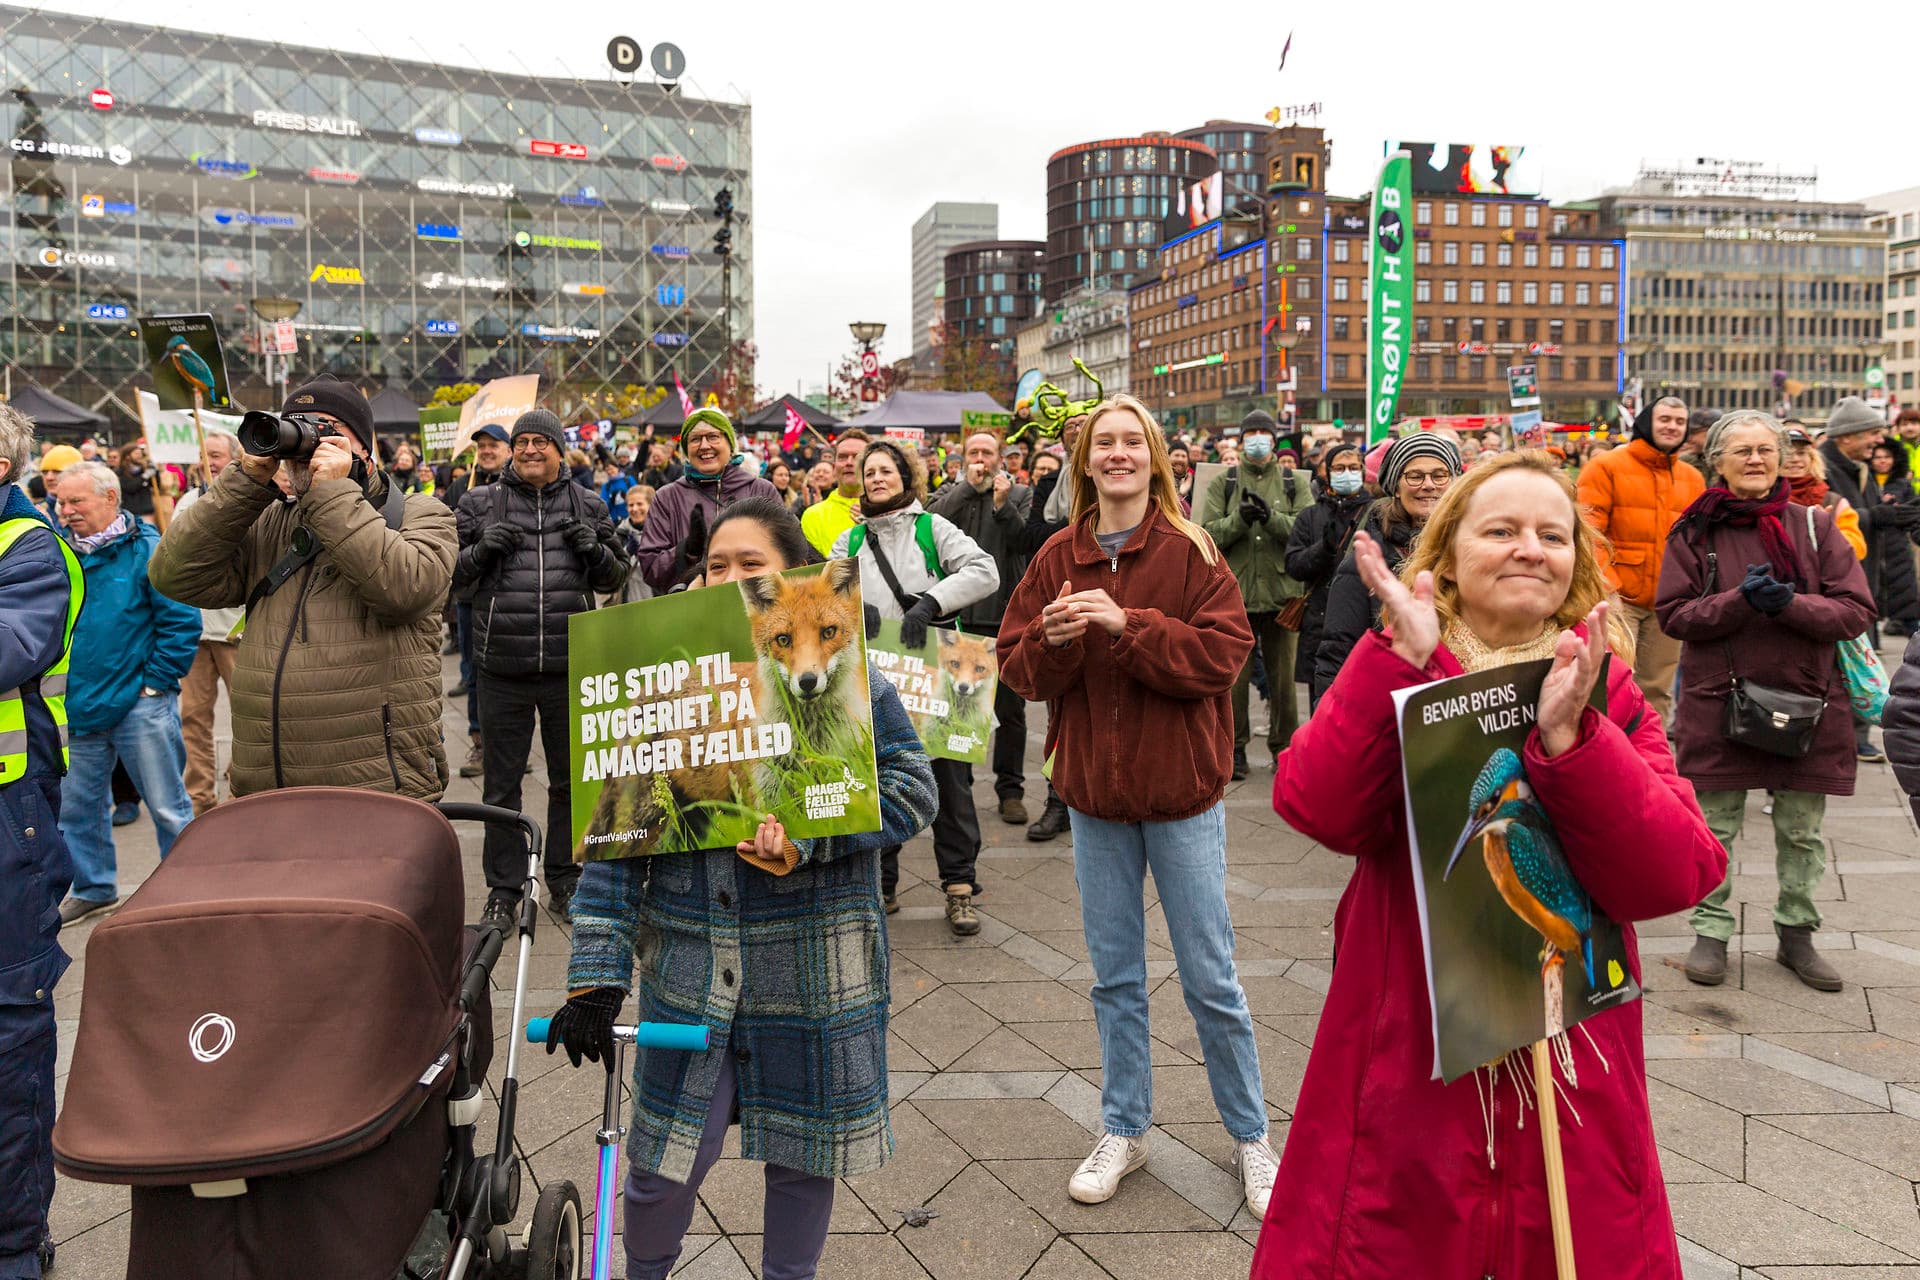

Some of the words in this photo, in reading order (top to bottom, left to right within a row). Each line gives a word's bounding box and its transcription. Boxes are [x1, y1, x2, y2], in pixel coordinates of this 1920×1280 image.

[617, 44, 634, 64] D
[1286, 102, 1322, 119] THAI
[1378, 186, 1401, 282] HÅB
[1750, 228, 1772, 240] The
[1774, 229, 1816, 243] Square
[89, 304, 127, 319] JKS
[1376, 291, 1401, 425] GRØNT
[563, 419, 612, 441] TOP
[866, 649, 899, 669] TOP
[903, 655, 926, 675] TIL
[580, 672, 618, 707] SIG
[625, 660, 690, 703] STOP
[696, 651, 737, 687] TIL
[911, 671, 933, 696] PÅ
[581, 693, 714, 745] BYGGERIET
[720, 677, 757, 723] PÅ
[1423, 695, 1470, 725] BEVAR
[1471, 683, 1517, 712] BYENS
[1477, 707, 1520, 735] VILDE
[582, 738, 684, 782] AMAGER
[690, 722, 793, 767] FÆLLED
[805, 781, 846, 798] AMAGER
[805, 792, 850, 809] FÆLLEDS
[806, 805, 846, 821] VENNER
